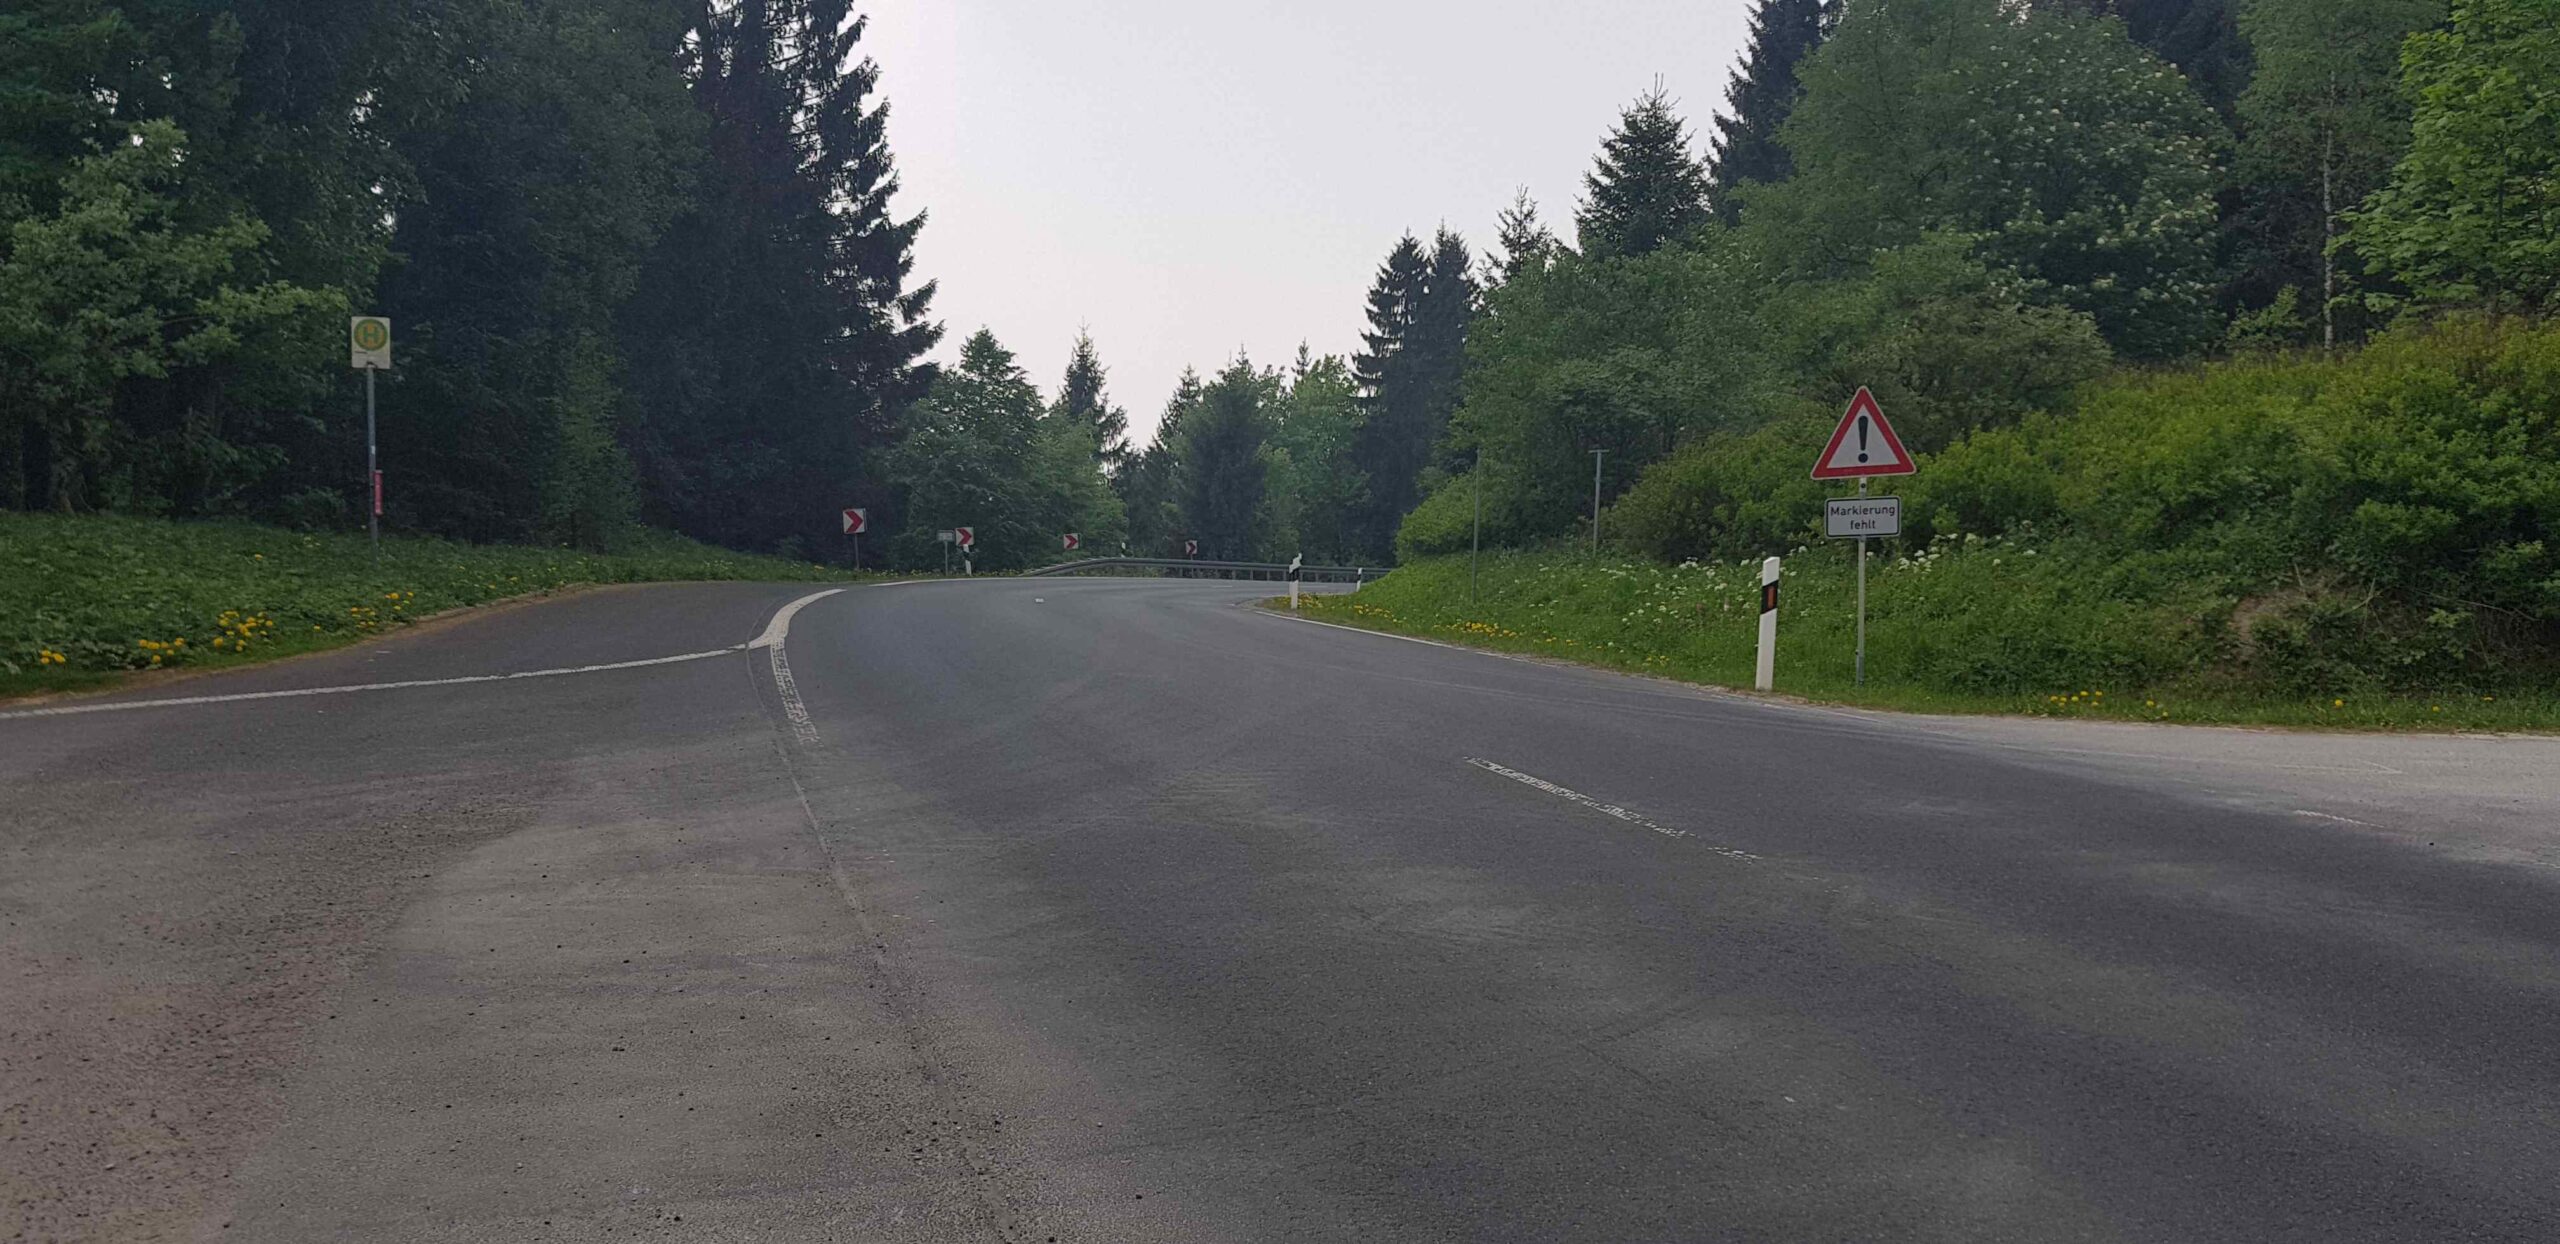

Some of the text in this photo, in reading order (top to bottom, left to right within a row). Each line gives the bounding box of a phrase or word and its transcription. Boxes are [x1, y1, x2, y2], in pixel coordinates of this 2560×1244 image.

[363, 324, 379, 345] H
[1830, 505, 1896, 517] Markierung
[1850, 520, 1876, 530] fehlt
